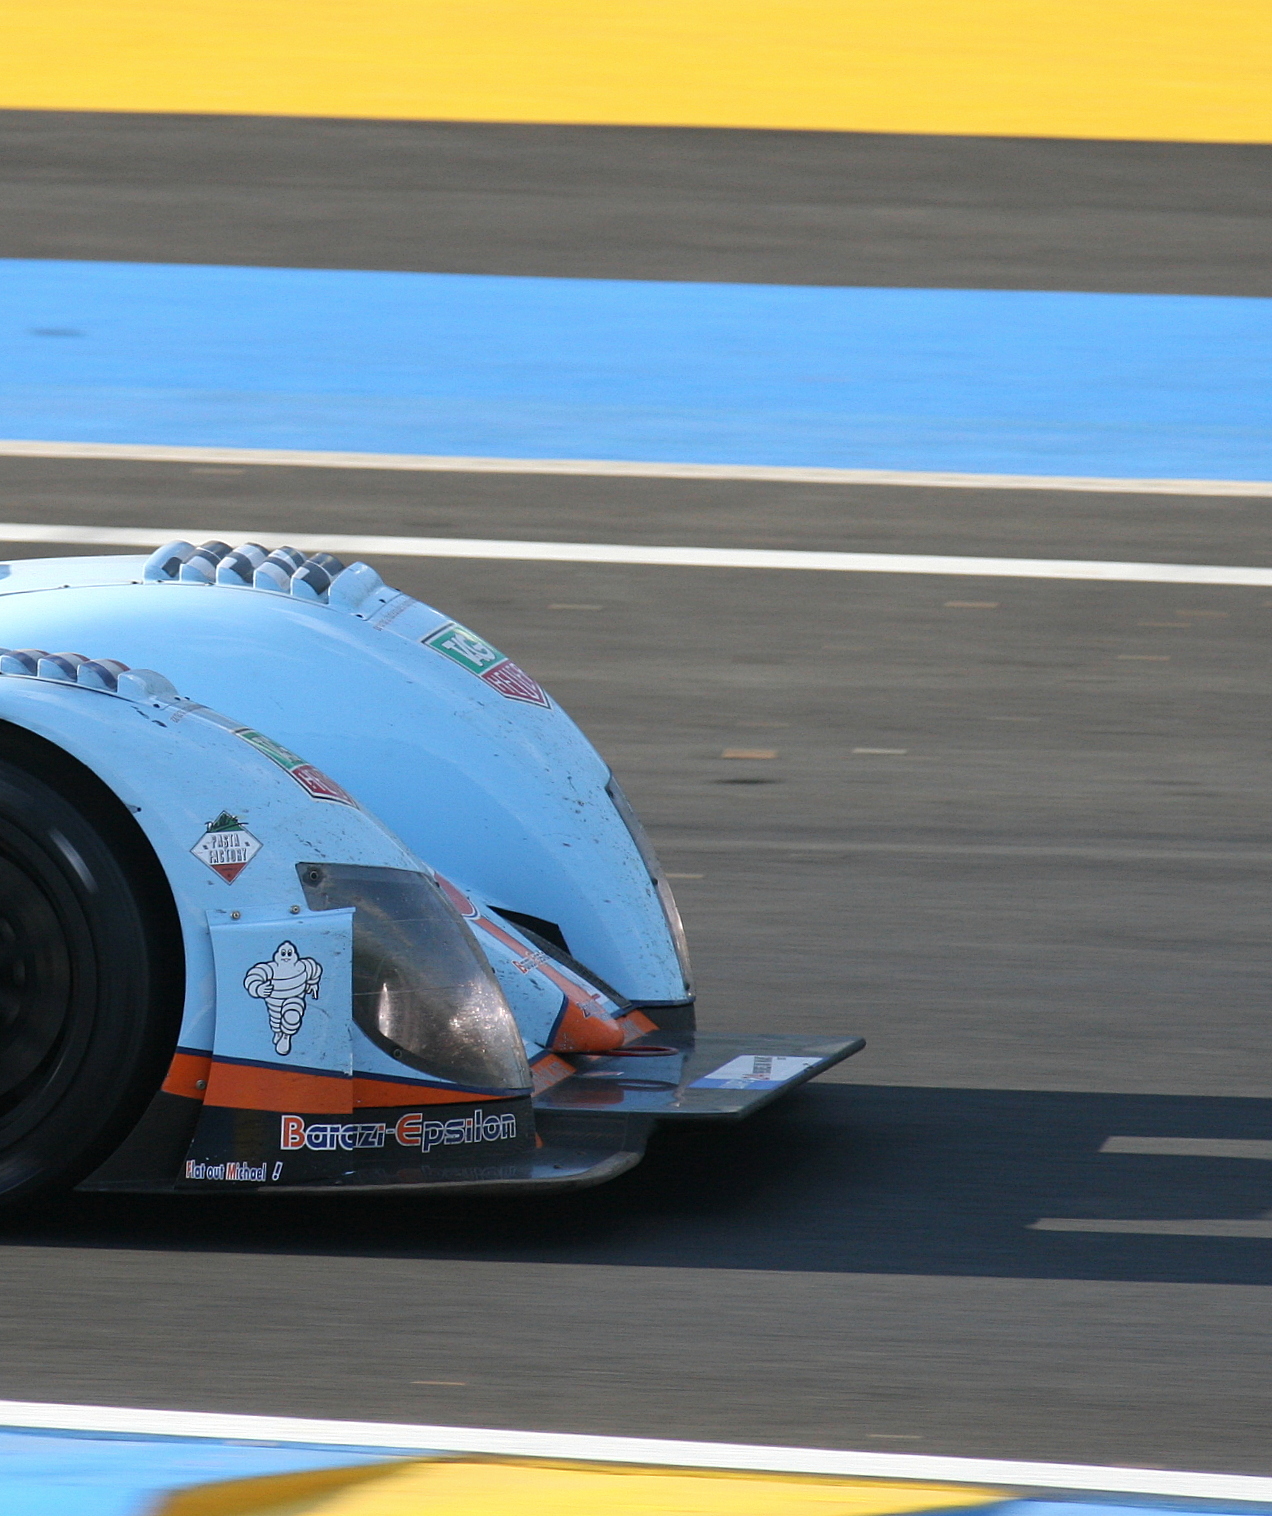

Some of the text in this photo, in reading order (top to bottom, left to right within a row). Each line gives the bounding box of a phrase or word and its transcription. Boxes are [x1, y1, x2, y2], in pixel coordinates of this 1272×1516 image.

[211, 832, 241, 849] PASTA
[209, 847, 248, 864] FACTORY
[280, 1109, 517, 1153] Barazi-Epsilon
[186, 1160, 206, 1179] Flat
[206, 1164, 225, 1180] out
[225, 1161, 267, 1182] Michael
